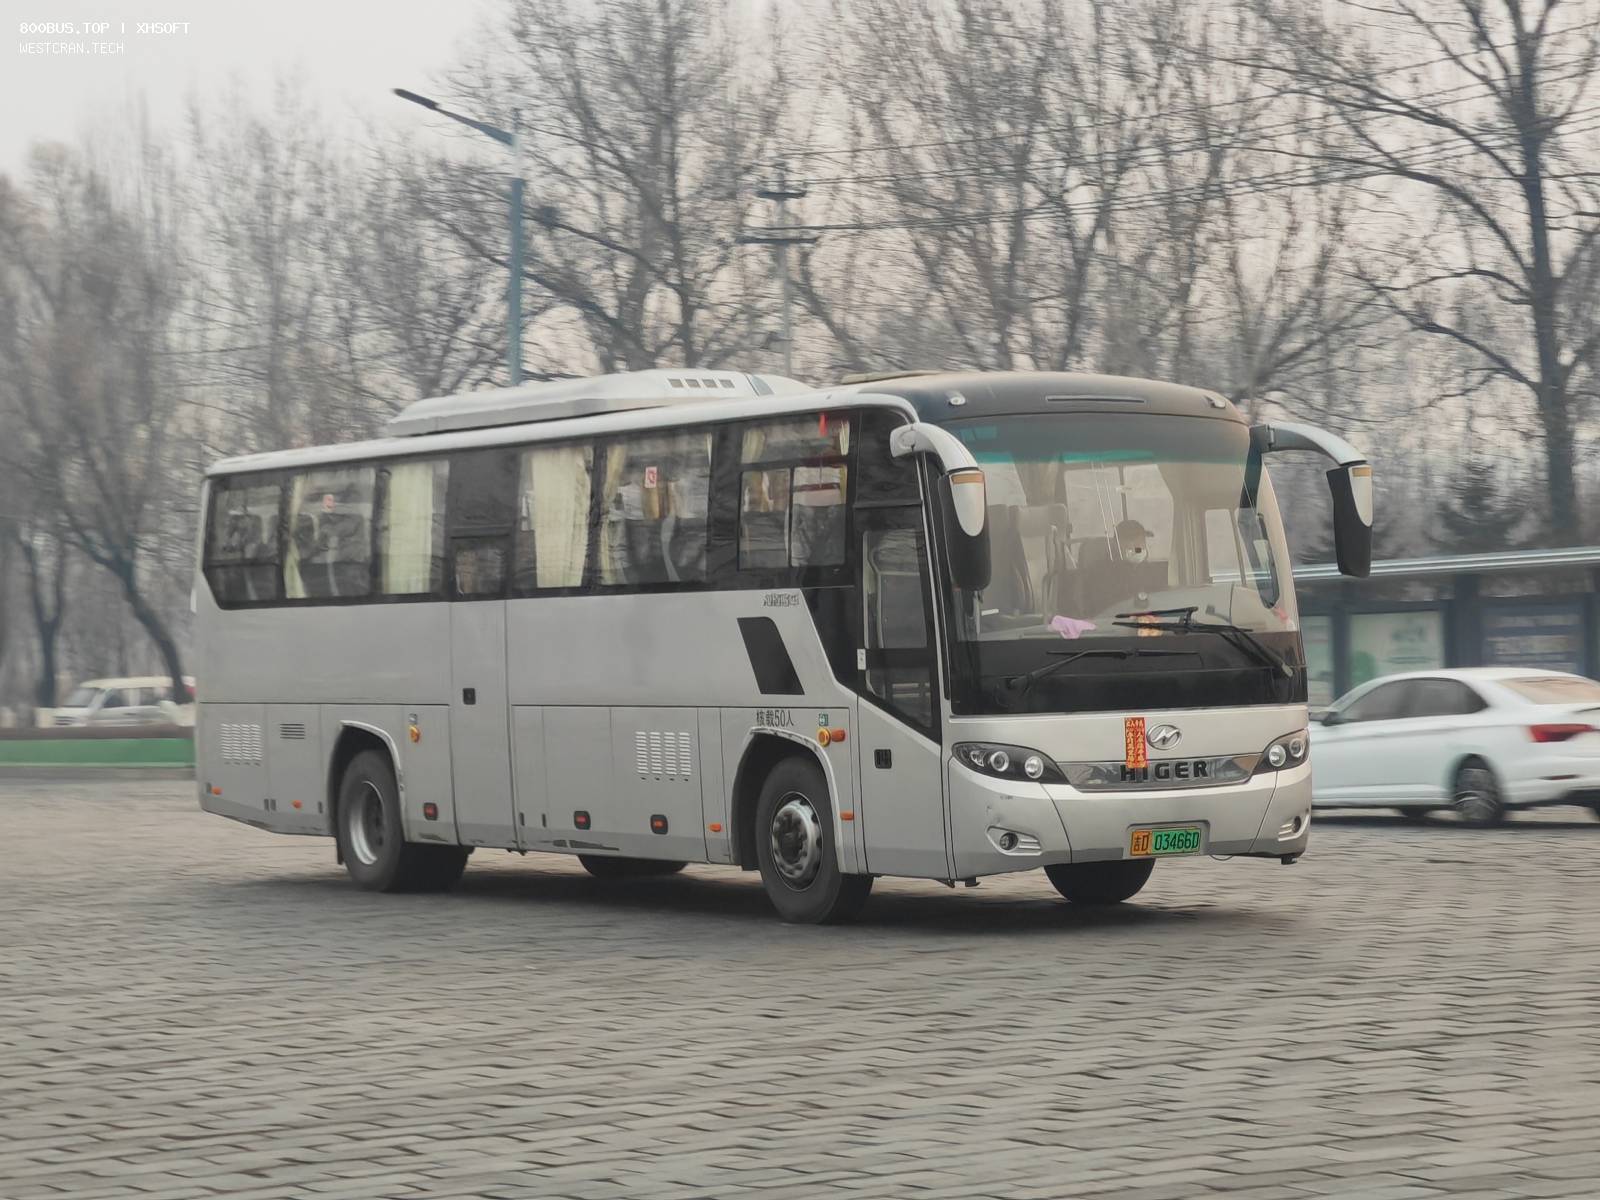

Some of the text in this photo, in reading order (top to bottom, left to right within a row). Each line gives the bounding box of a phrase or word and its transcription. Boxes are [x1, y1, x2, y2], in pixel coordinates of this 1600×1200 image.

[756, 709, 794, 728] 核载50人
[1120, 760, 1209, 782] HIGER
